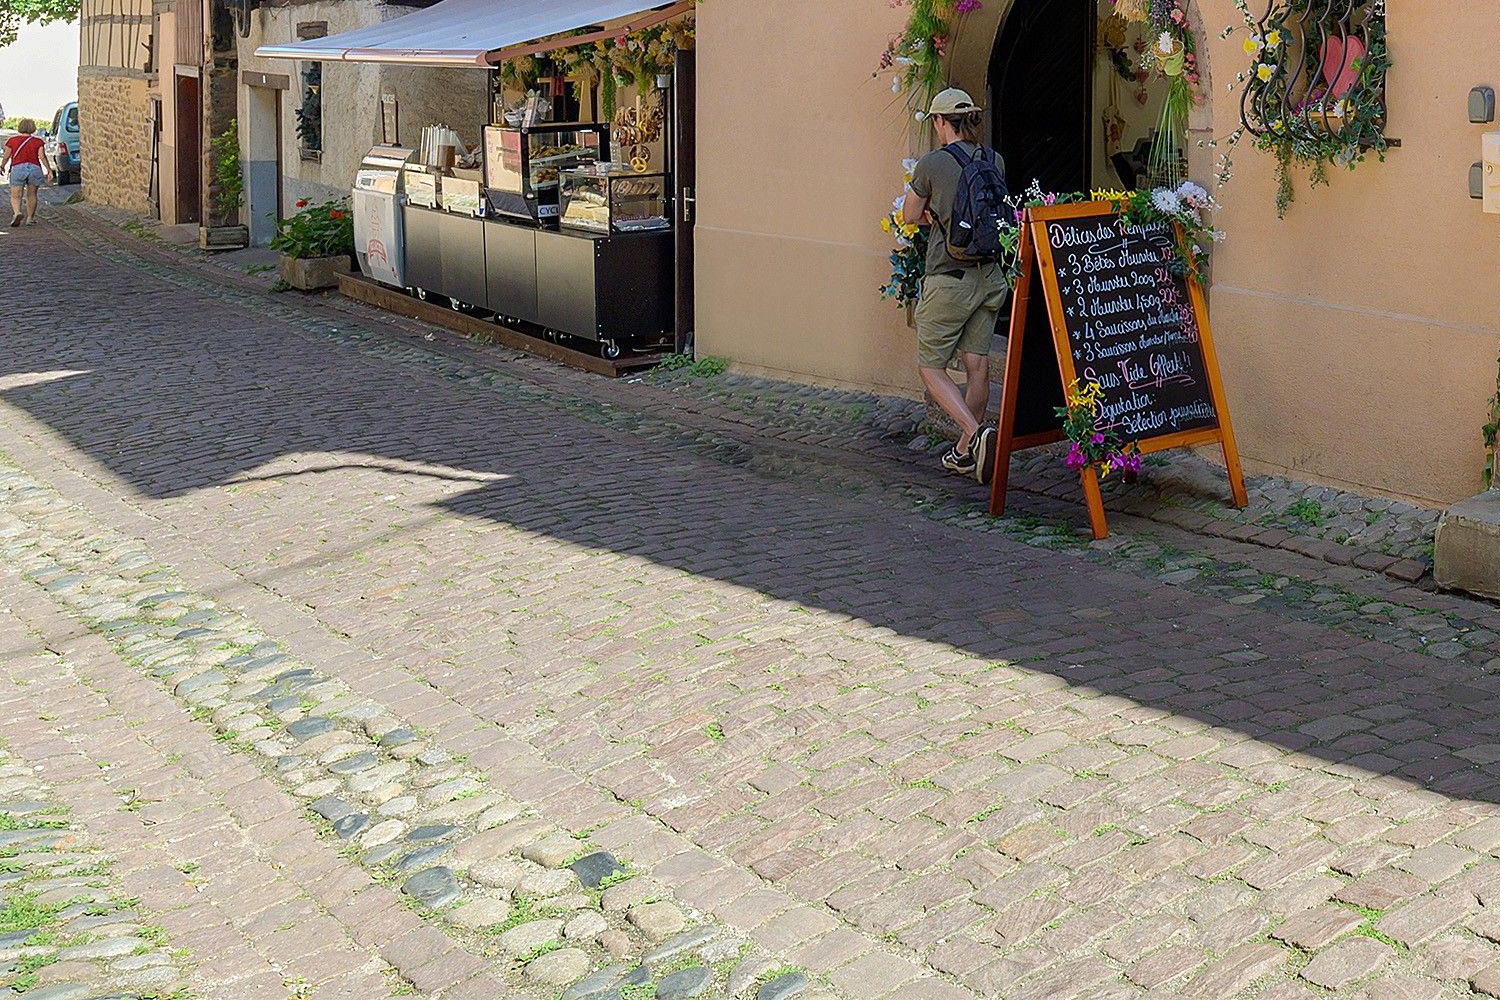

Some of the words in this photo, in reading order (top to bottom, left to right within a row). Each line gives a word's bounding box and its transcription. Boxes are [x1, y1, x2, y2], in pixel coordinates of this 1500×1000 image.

[1068, 253, 1081, 275] 3
[1073, 278, 1084, 295] 3
[1077, 296, 1089, 317] 2
[1085, 322, 1095, 340] 4
[1083, 341, 1095, 361] 3
